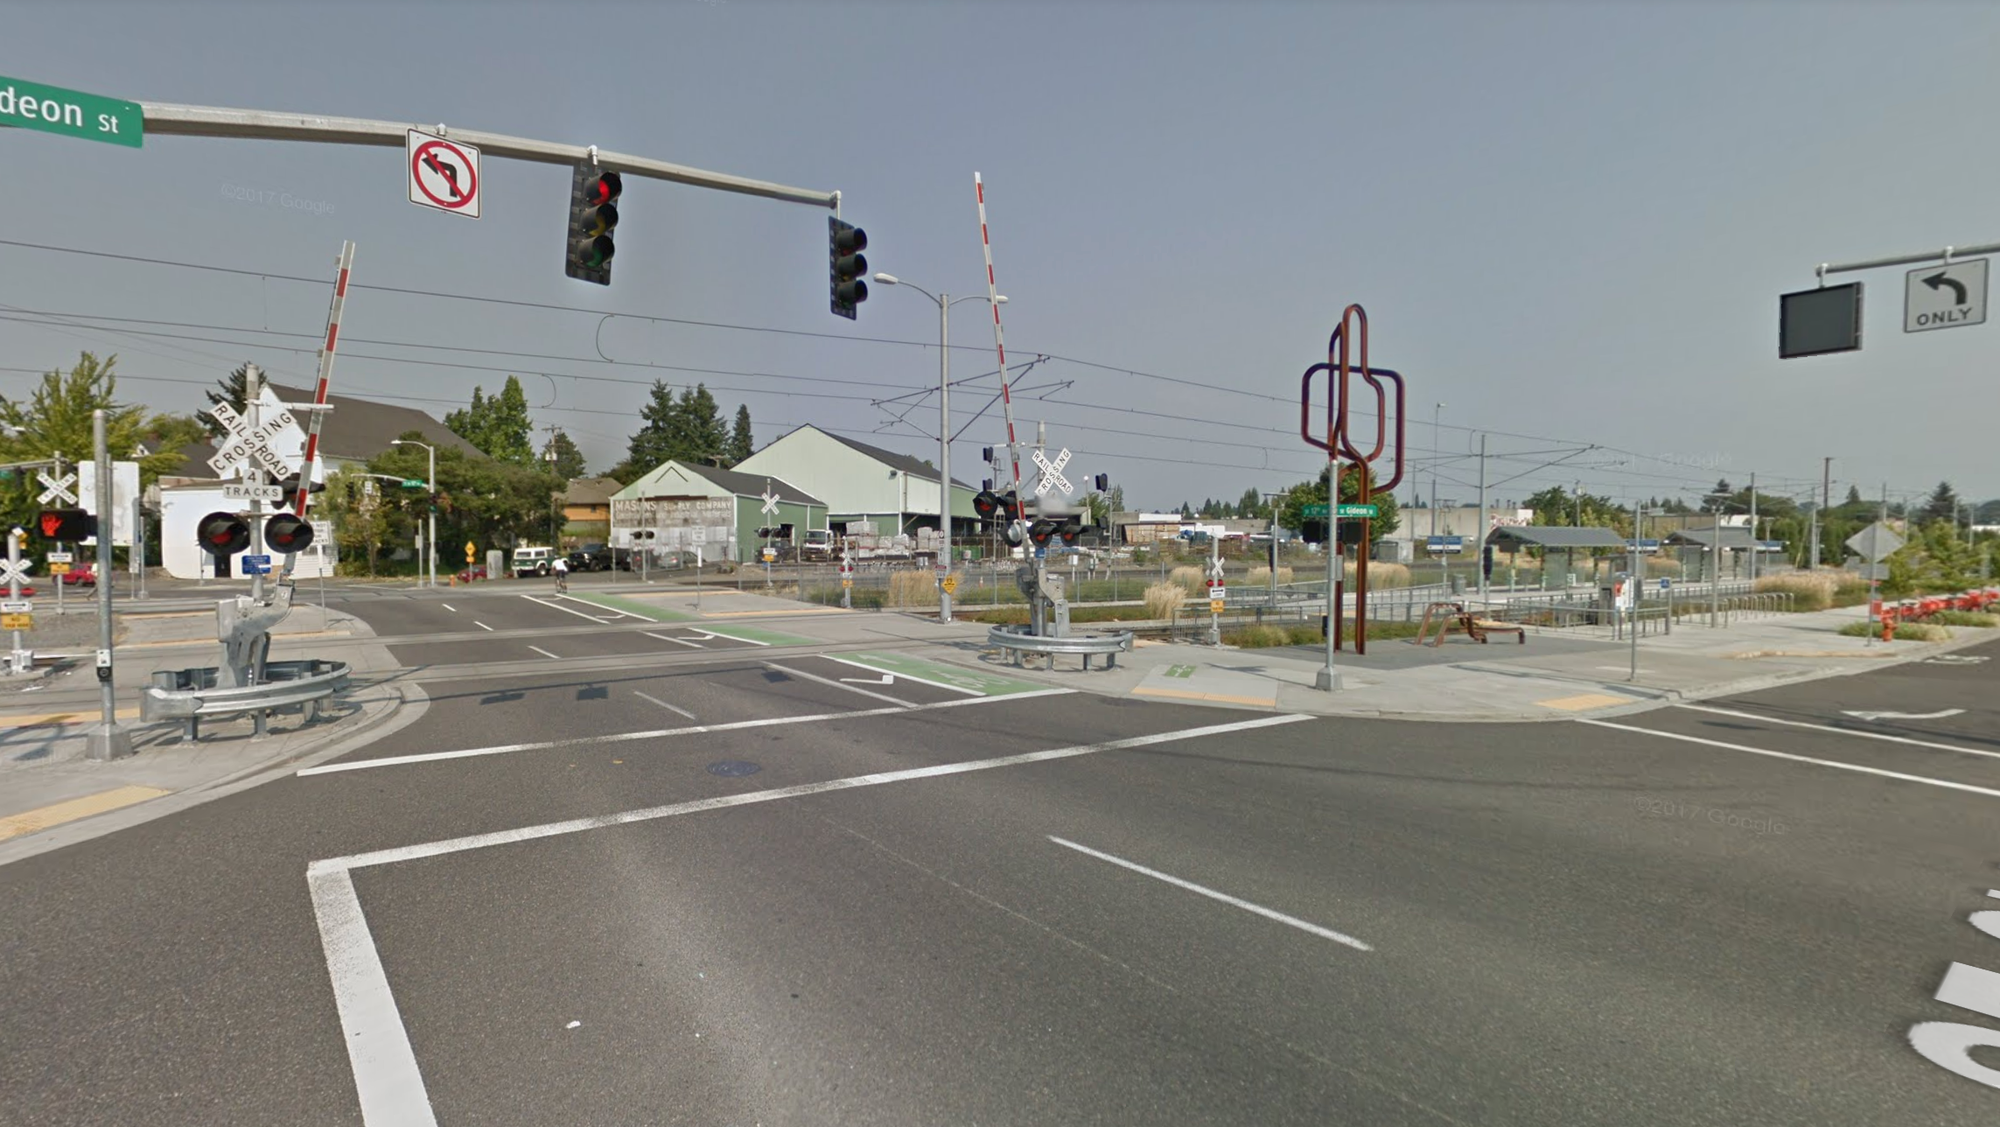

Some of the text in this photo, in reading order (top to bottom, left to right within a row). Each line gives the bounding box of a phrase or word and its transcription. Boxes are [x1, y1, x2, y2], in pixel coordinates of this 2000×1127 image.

[98, 114, 118, 133] St
[1917, 307, 1972, 326] ONLY
[213, 412, 292, 471] CROSSING
[247, 471, 257, 483] 4
[225, 487, 279, 497] TRACKS
[696, 501, 732, 510] COMPANY
[1346, 506, 1368, 515] Gideon
